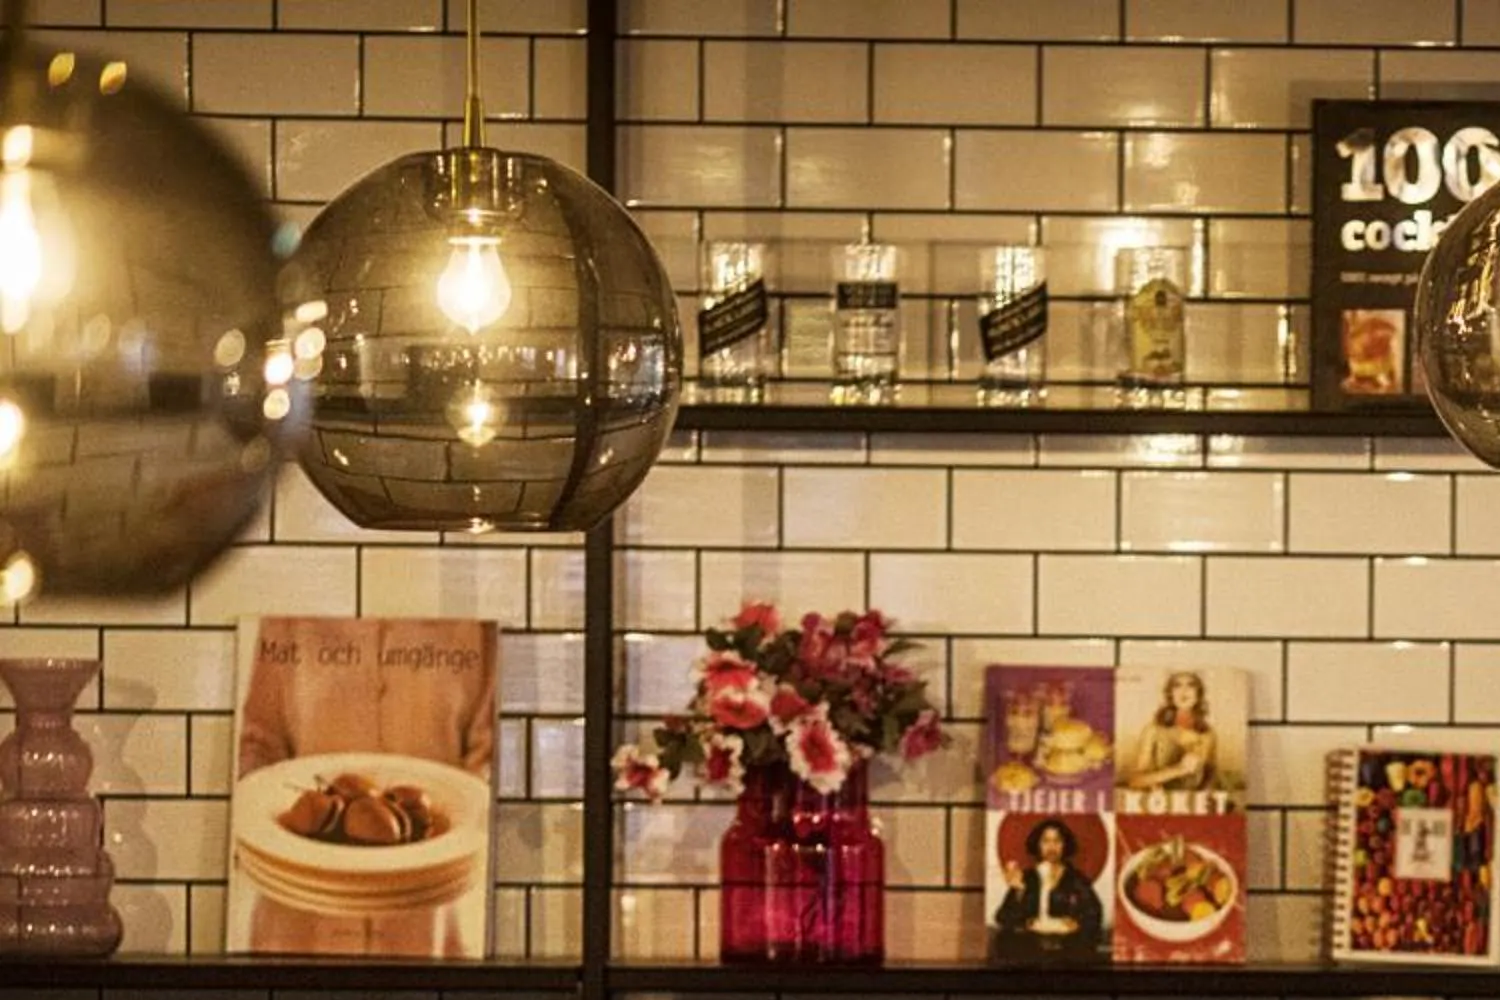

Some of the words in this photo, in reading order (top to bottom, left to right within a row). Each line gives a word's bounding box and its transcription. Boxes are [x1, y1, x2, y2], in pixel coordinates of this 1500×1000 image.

[259, 639, 302, 665] Mat
[318, 640, 361, 666] och
[377, 641, 480, 674] umgänge
